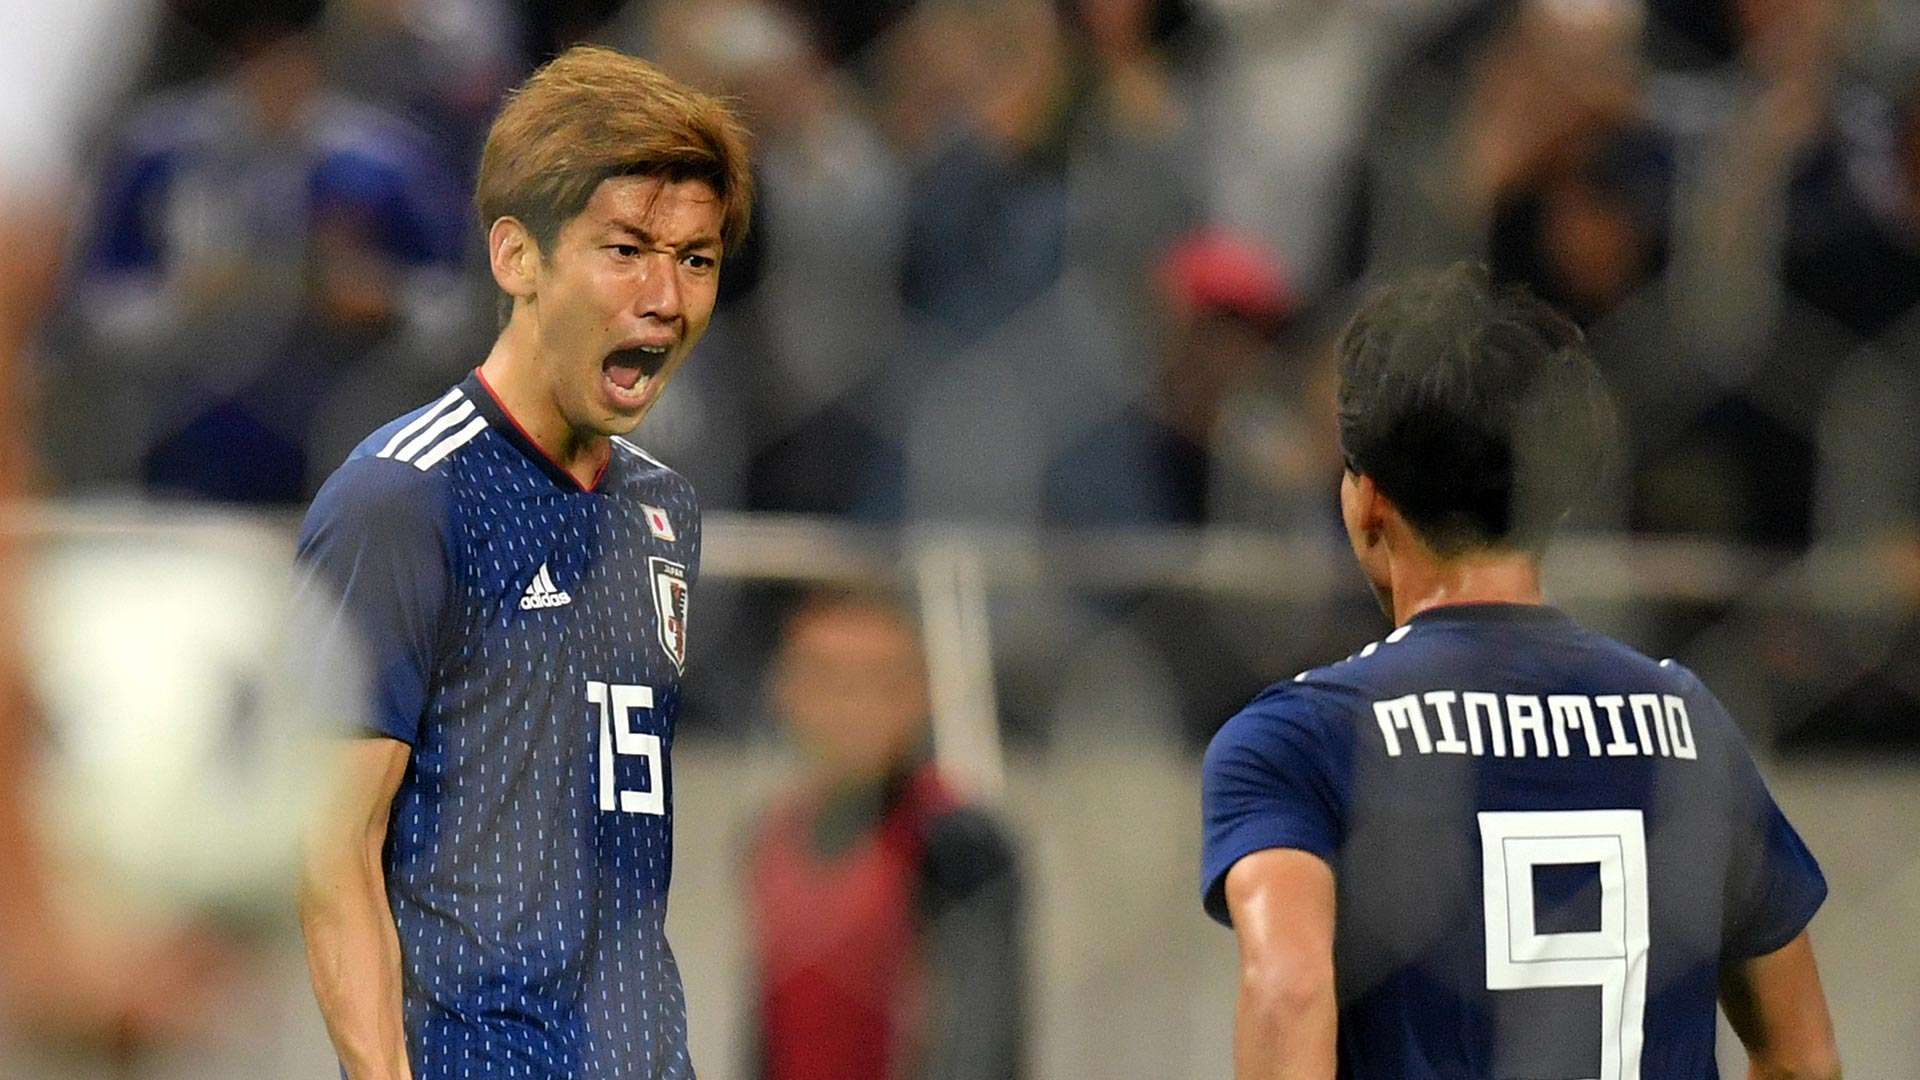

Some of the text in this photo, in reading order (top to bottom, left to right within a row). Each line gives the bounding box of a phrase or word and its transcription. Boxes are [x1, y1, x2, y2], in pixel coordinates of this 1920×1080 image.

[520, 591, 572, 610] adidas
[586, 680, 665, 815] 15
[1373, 691, 1697, 760] MINAMINO
[1477, 809, 1650, 1080] 9
